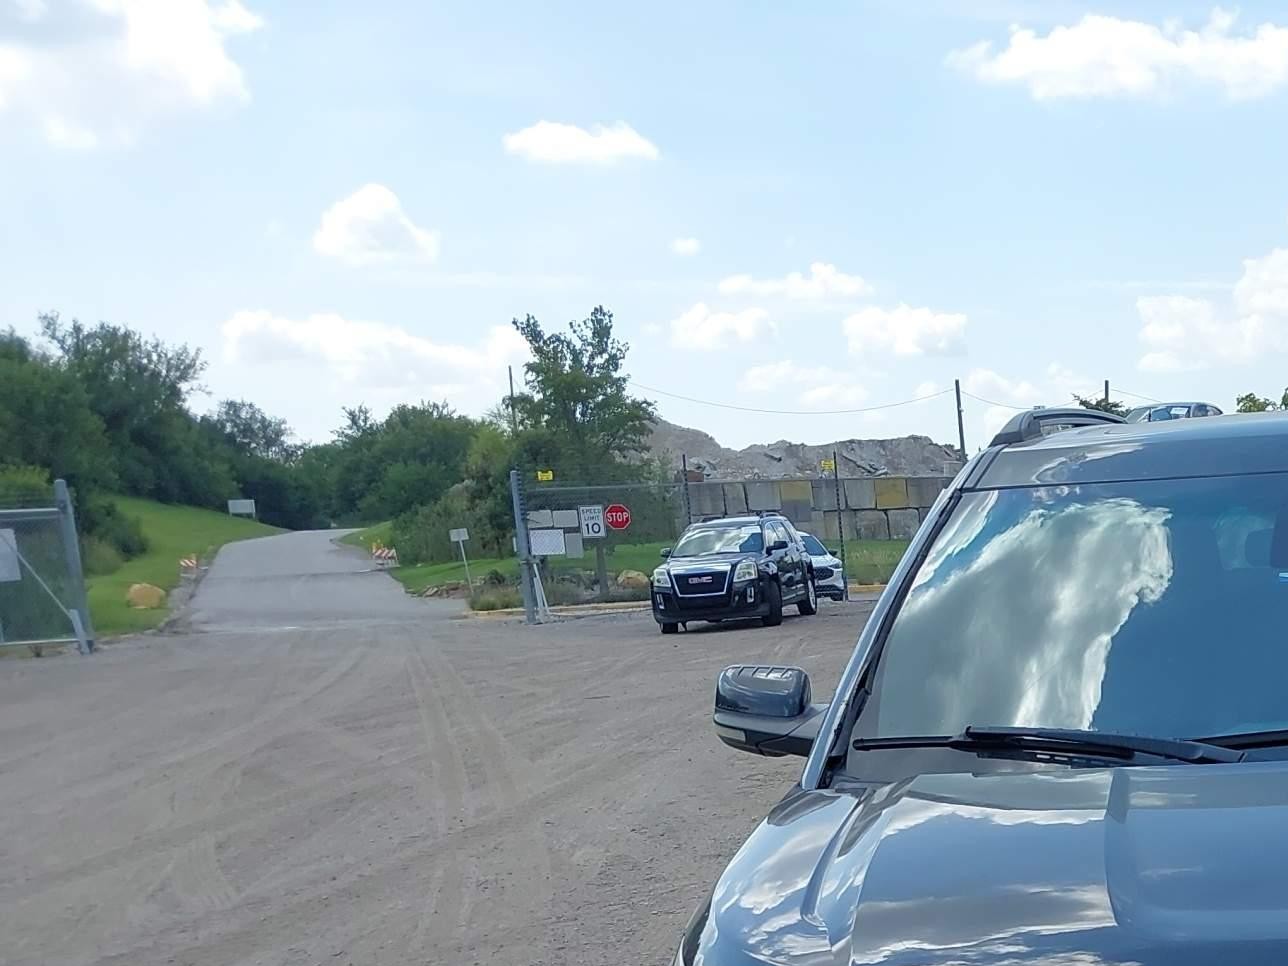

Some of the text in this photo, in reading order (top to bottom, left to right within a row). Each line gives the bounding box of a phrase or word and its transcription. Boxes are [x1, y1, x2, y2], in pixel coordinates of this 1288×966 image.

[607, 512, 629, 522] STOP
[585, 522, 601, 535] 10
[688, 576, 713, 585] GMC
